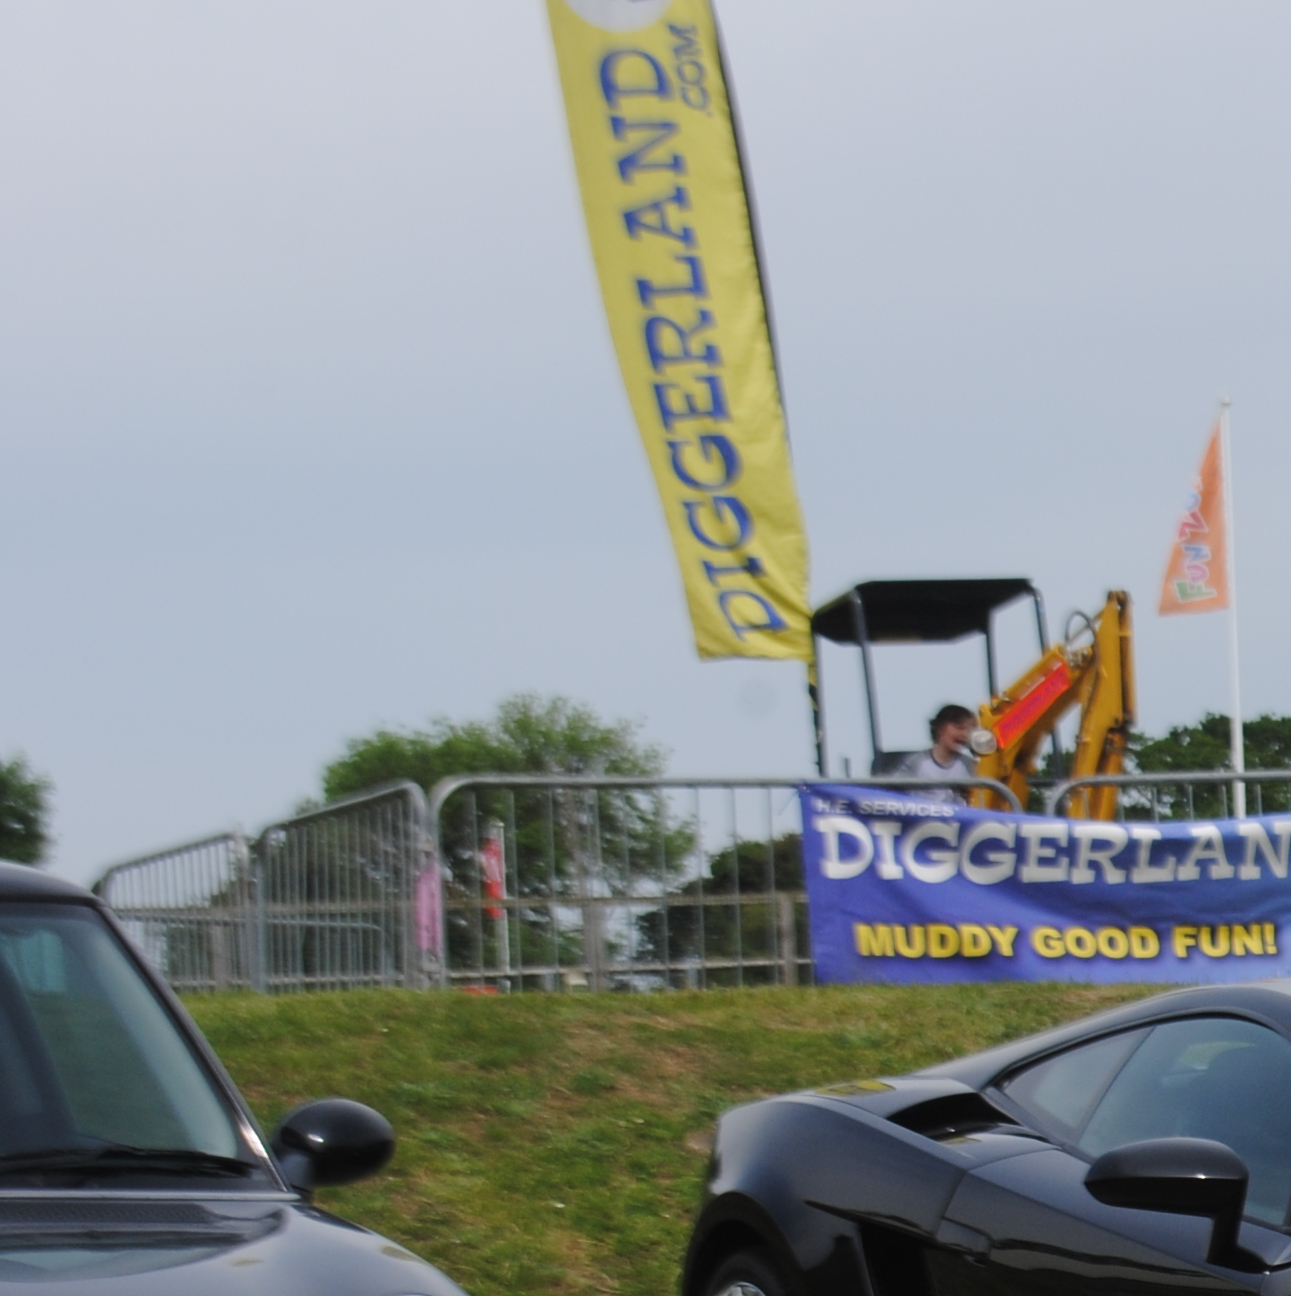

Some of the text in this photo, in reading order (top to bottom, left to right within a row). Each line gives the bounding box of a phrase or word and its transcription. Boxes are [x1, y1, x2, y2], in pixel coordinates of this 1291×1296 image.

[597, 47, 789, 642] DIGGERLAND
[854, 922, 1279, 960] MUDDY GOOD FUN!
